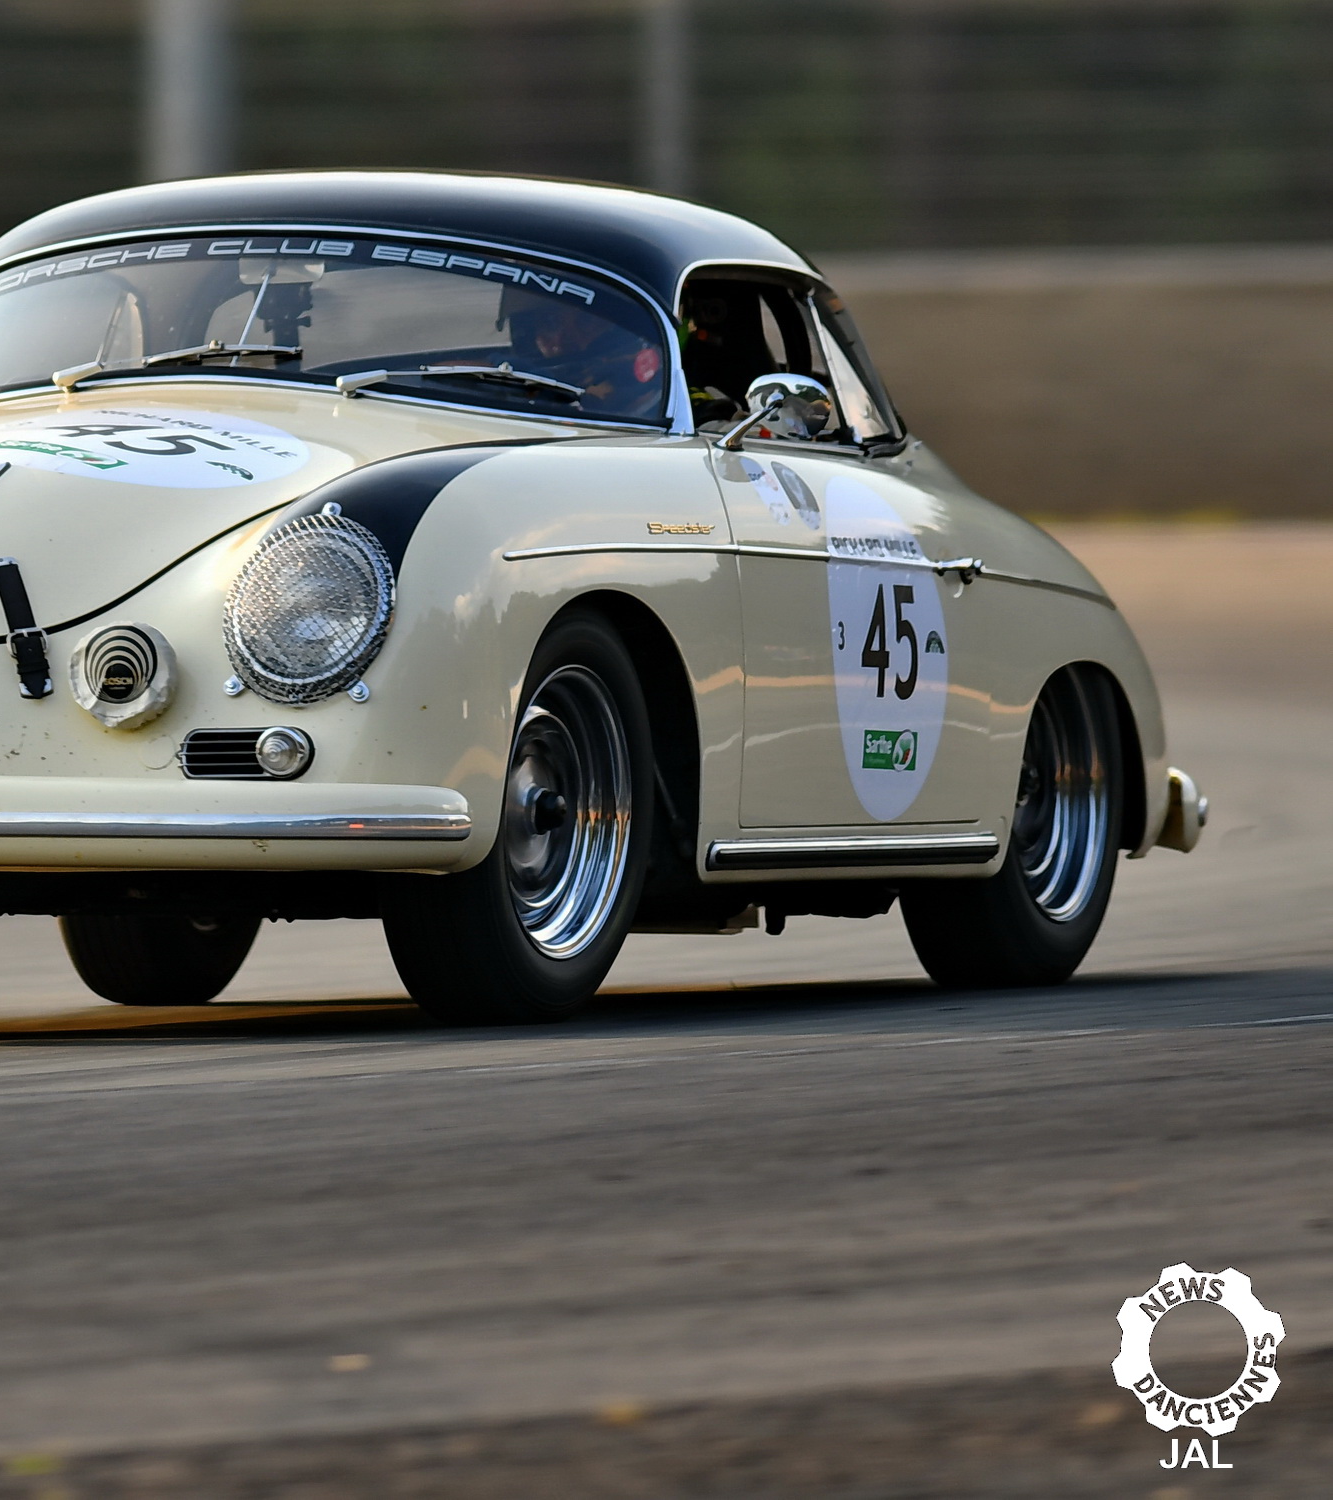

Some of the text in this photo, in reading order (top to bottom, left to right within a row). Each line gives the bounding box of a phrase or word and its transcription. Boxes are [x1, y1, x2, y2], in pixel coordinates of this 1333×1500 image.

[206, 239, 354, 258] CLUB
[371, 244, 596, 305] ESPAÑA
[45, 424, 236, 456] 45
[837, 620, 845, 651] 3
[861, 583, 919, 700] 45
